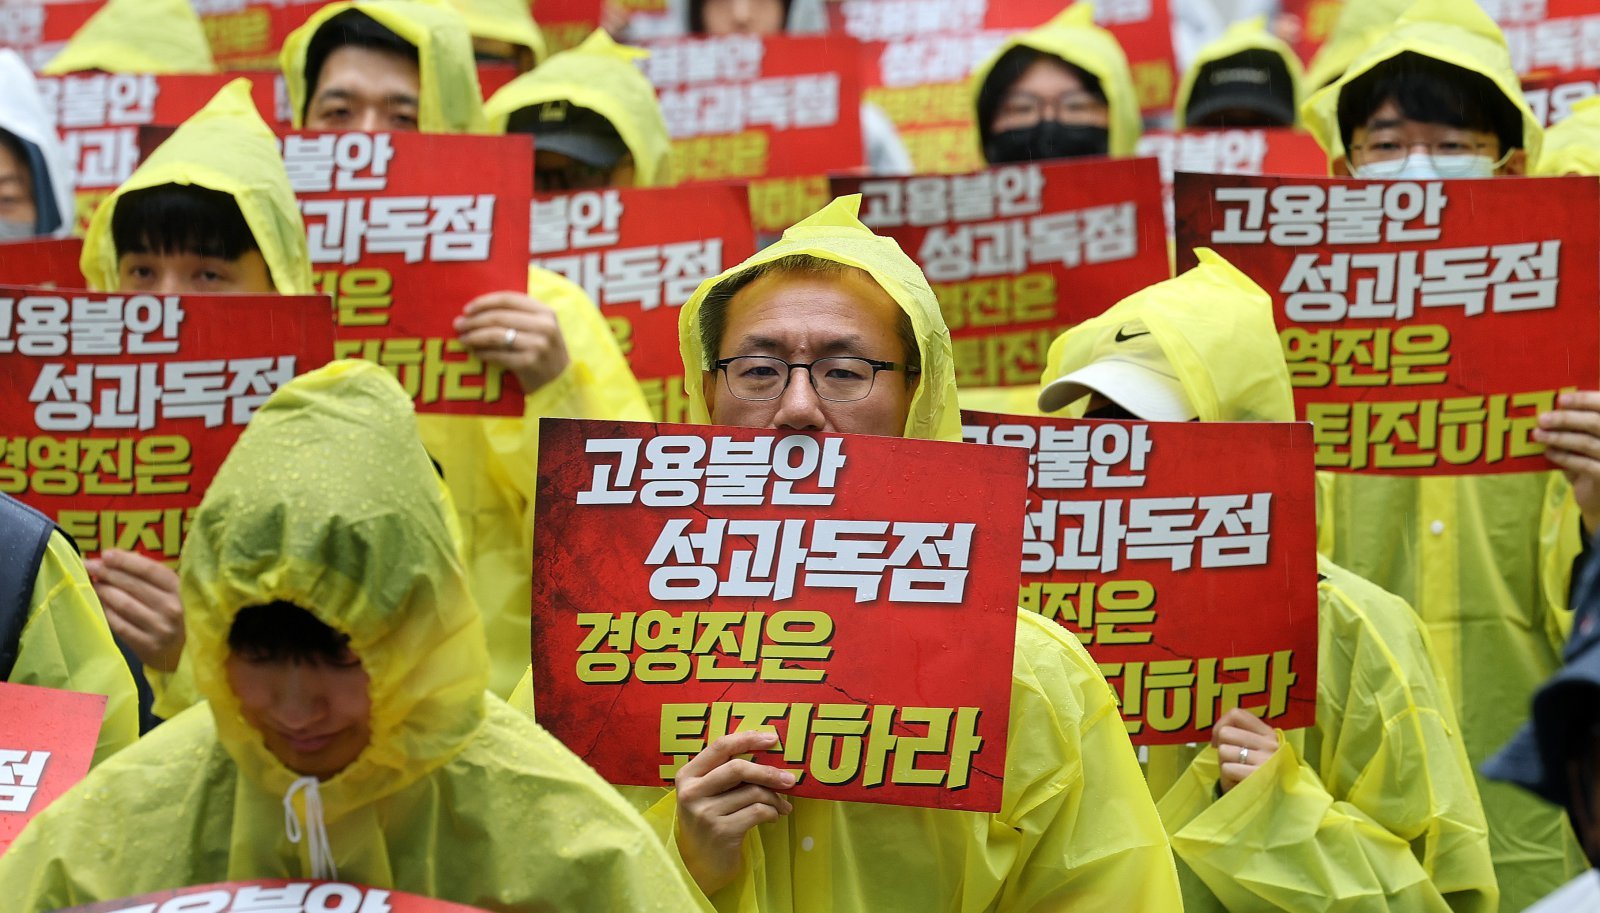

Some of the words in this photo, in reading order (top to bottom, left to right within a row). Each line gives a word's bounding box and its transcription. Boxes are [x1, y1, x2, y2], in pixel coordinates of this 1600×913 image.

[276, 133, 394, 193] 불안
[859, 165, 1045, 228] 고용불안
[297, 193, 496, 266] 과독점
[530, 189, 624, 255] 불안
[919, 202, 1138, 282] 성과독점
[1211, 181, 1447, 246] 고용불안
[1279, 239, 1562, 322] 성과독점
[1279, 324, 1451, 388] 영진은
[576, 435, 847, 507] 고용불안
[644, 518, 976, 604] 성과독점
[576, 609, 836, 686] 경영진은
